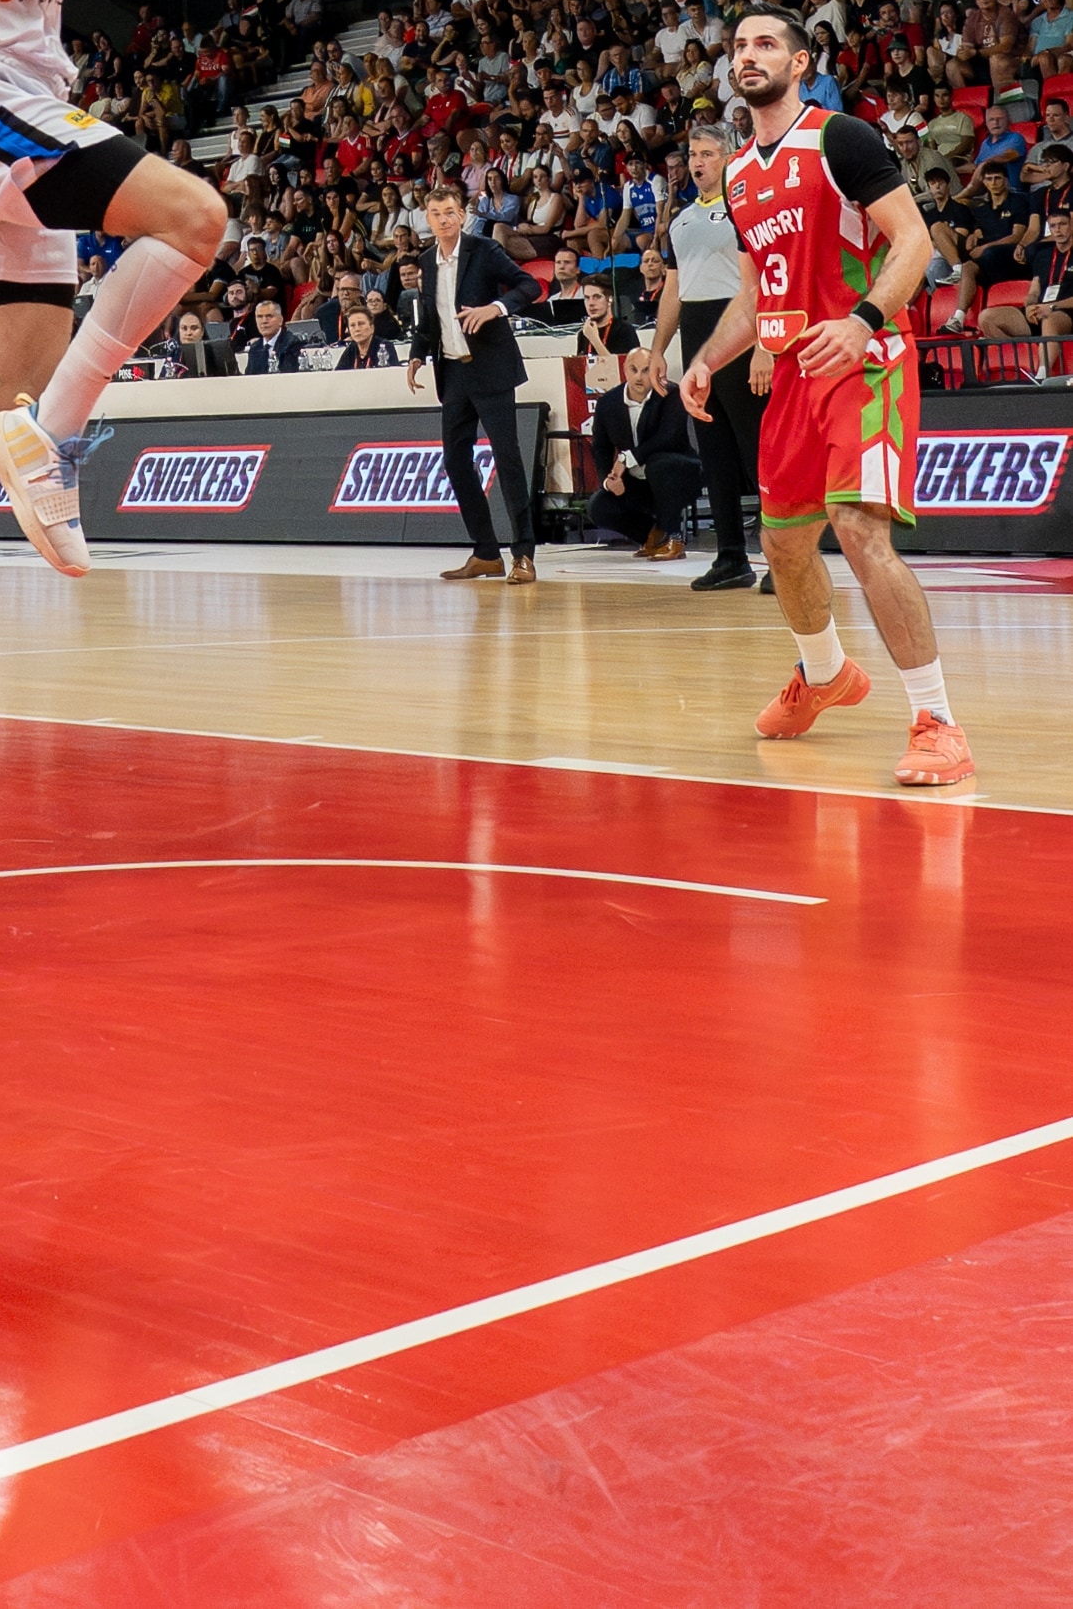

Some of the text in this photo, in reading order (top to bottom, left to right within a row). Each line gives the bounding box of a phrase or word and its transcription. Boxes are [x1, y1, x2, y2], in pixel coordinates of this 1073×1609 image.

[760, 253, 789, 296] 13
[760, 319, 787, 339] MOL
[129, 455, 257, 503] SNICKERS
[341, 449, 496, 503] SNICKES
[917, 441, 1060, 502] CKERS
